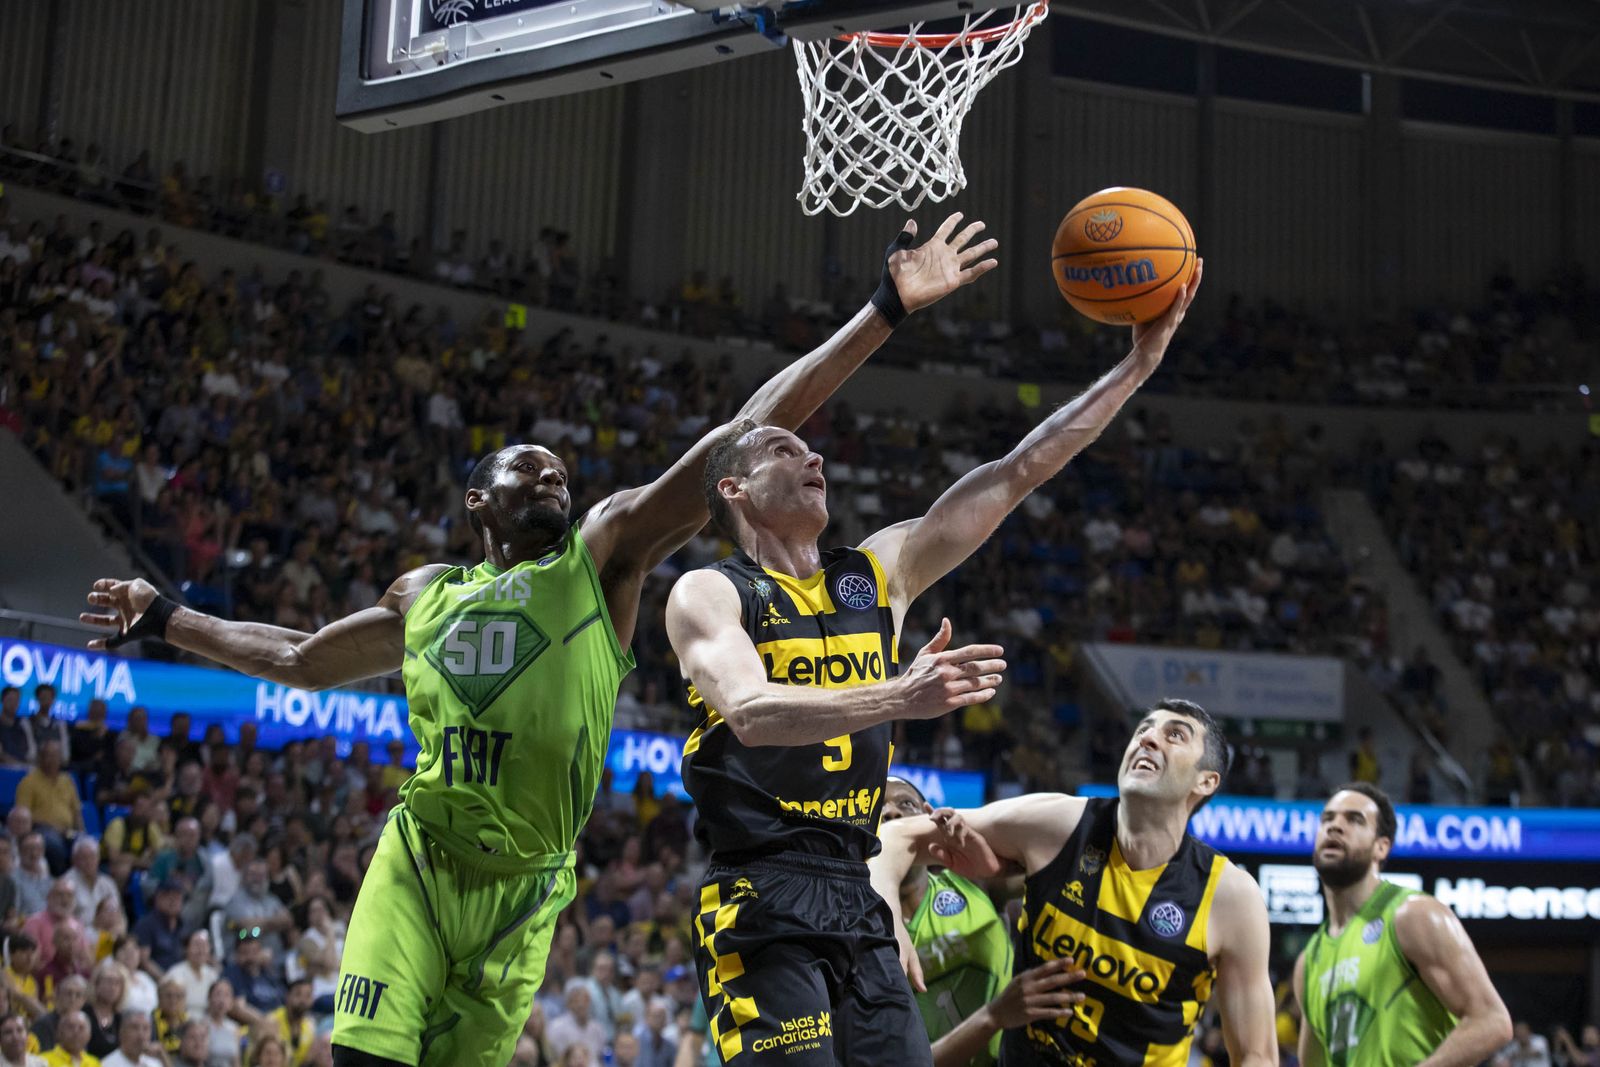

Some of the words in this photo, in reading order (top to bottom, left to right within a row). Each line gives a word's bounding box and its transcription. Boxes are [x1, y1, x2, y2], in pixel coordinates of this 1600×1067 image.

[1063, 258, 1159, 289] Wilson
[0, 643, 137, 704] OVIMA
[443, 620, 518, 676] 50
[255, 682, 404, 738] HOVIMA
[443, 726, 513, 788] FIAT
[1035, 914, 1160, 994] Lenovo
[337, 973, 389, 1021] FIAT
[781, 1015, 815, 1032] Islas
